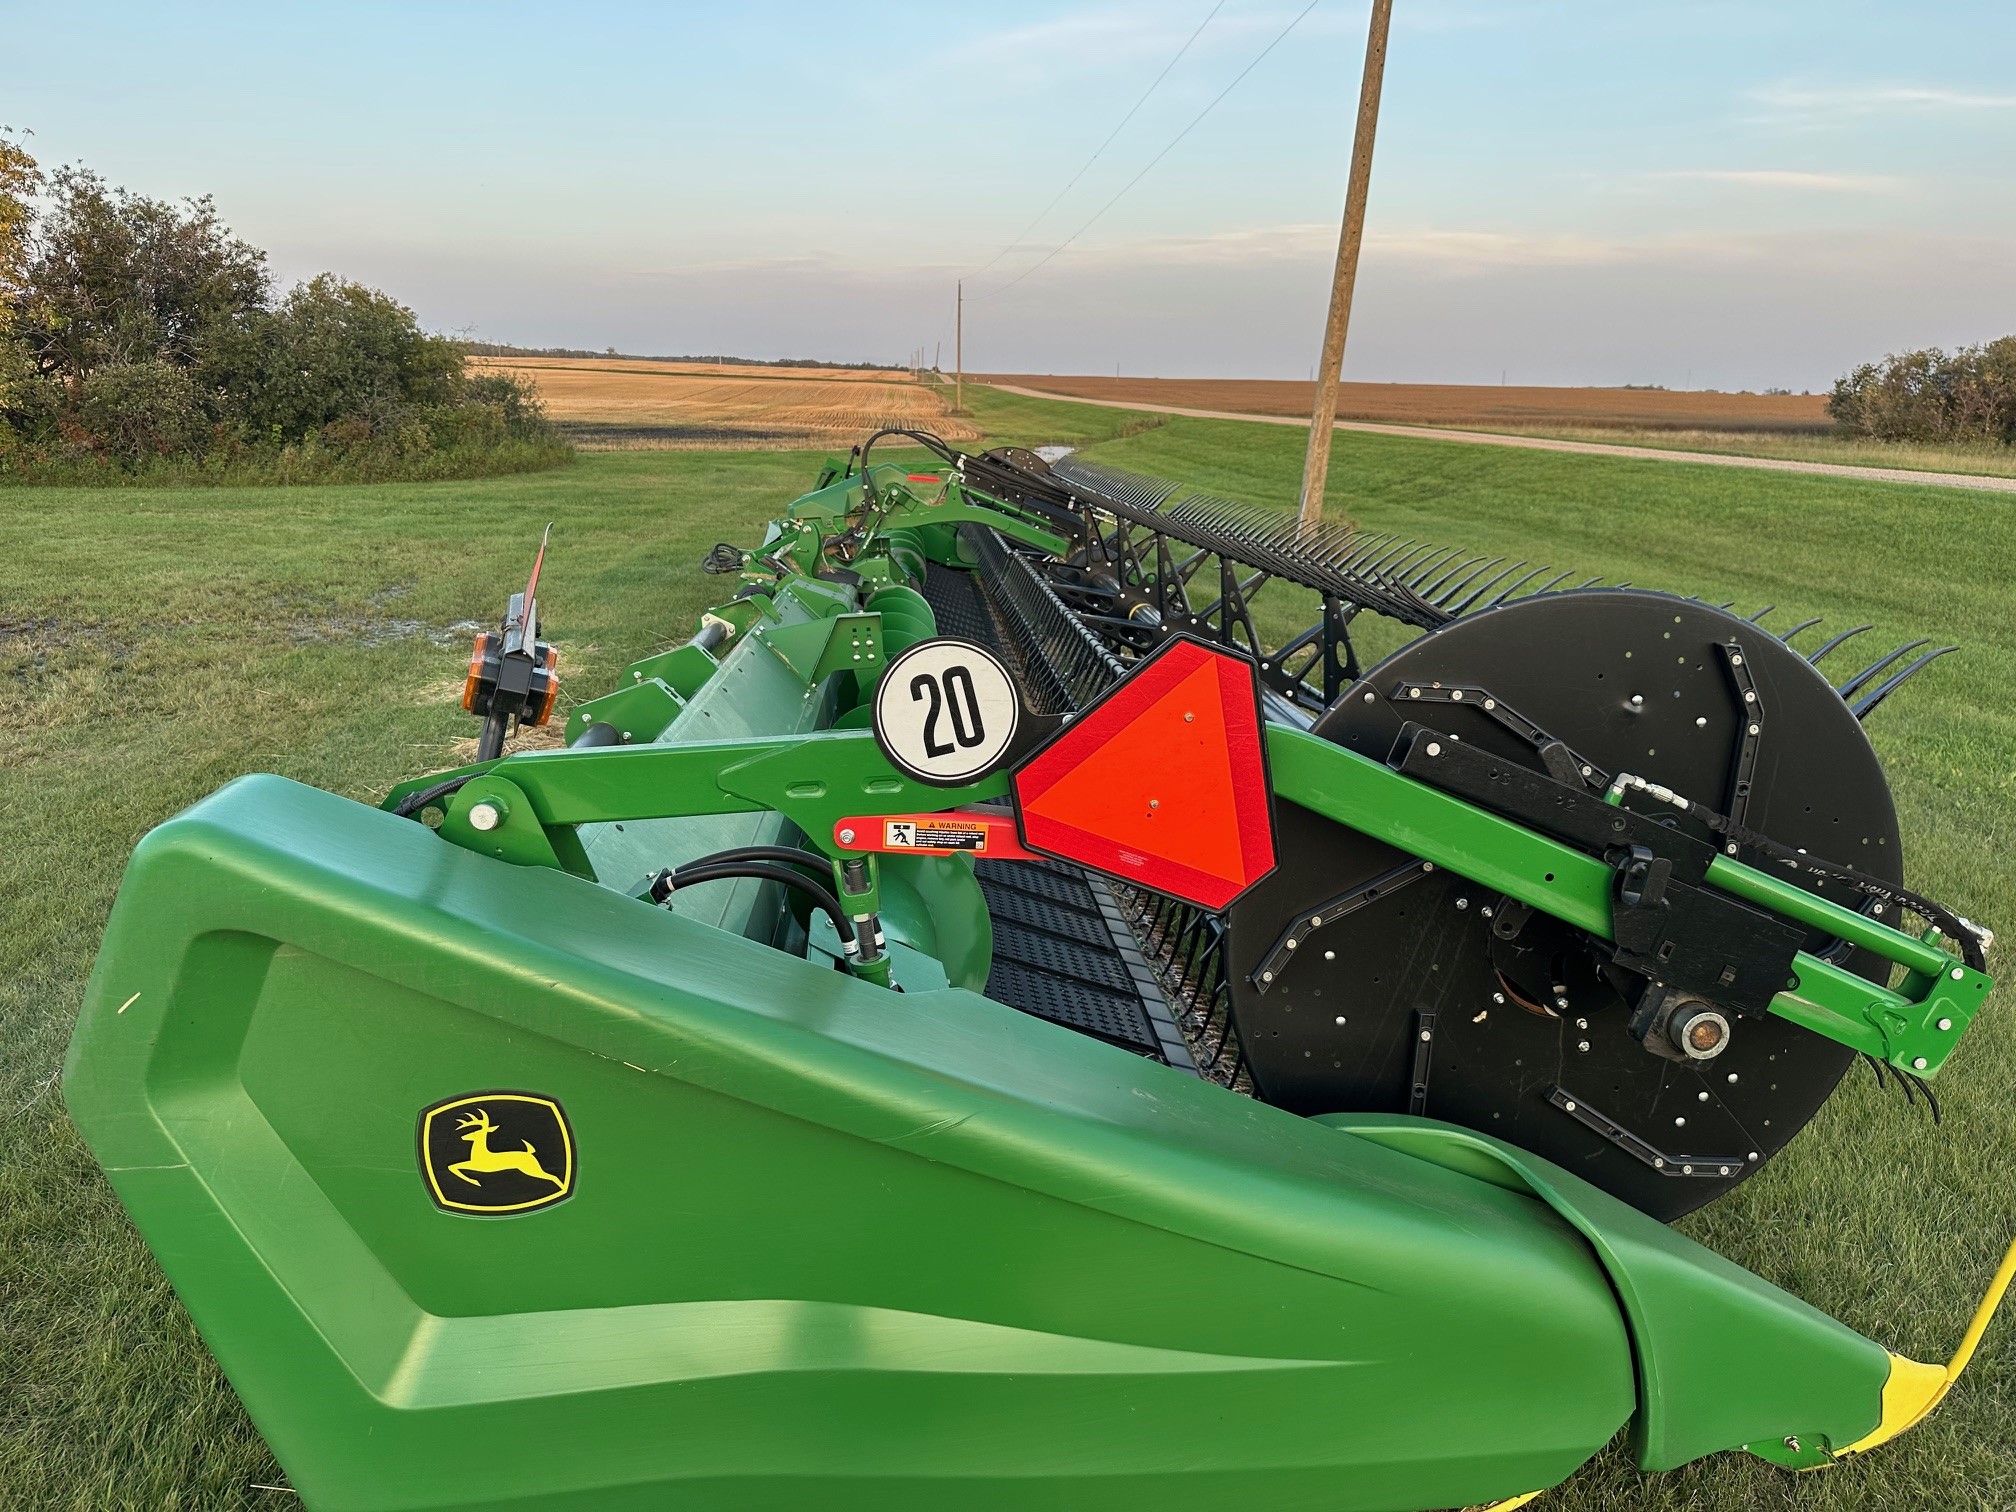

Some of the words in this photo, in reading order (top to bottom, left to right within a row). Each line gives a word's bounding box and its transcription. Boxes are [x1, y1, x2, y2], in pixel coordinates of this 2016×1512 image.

[910, 665, 985, 758] 20
[1501, 772, 1511, 785] 3
[938, 822, 977, 830] WARNING
